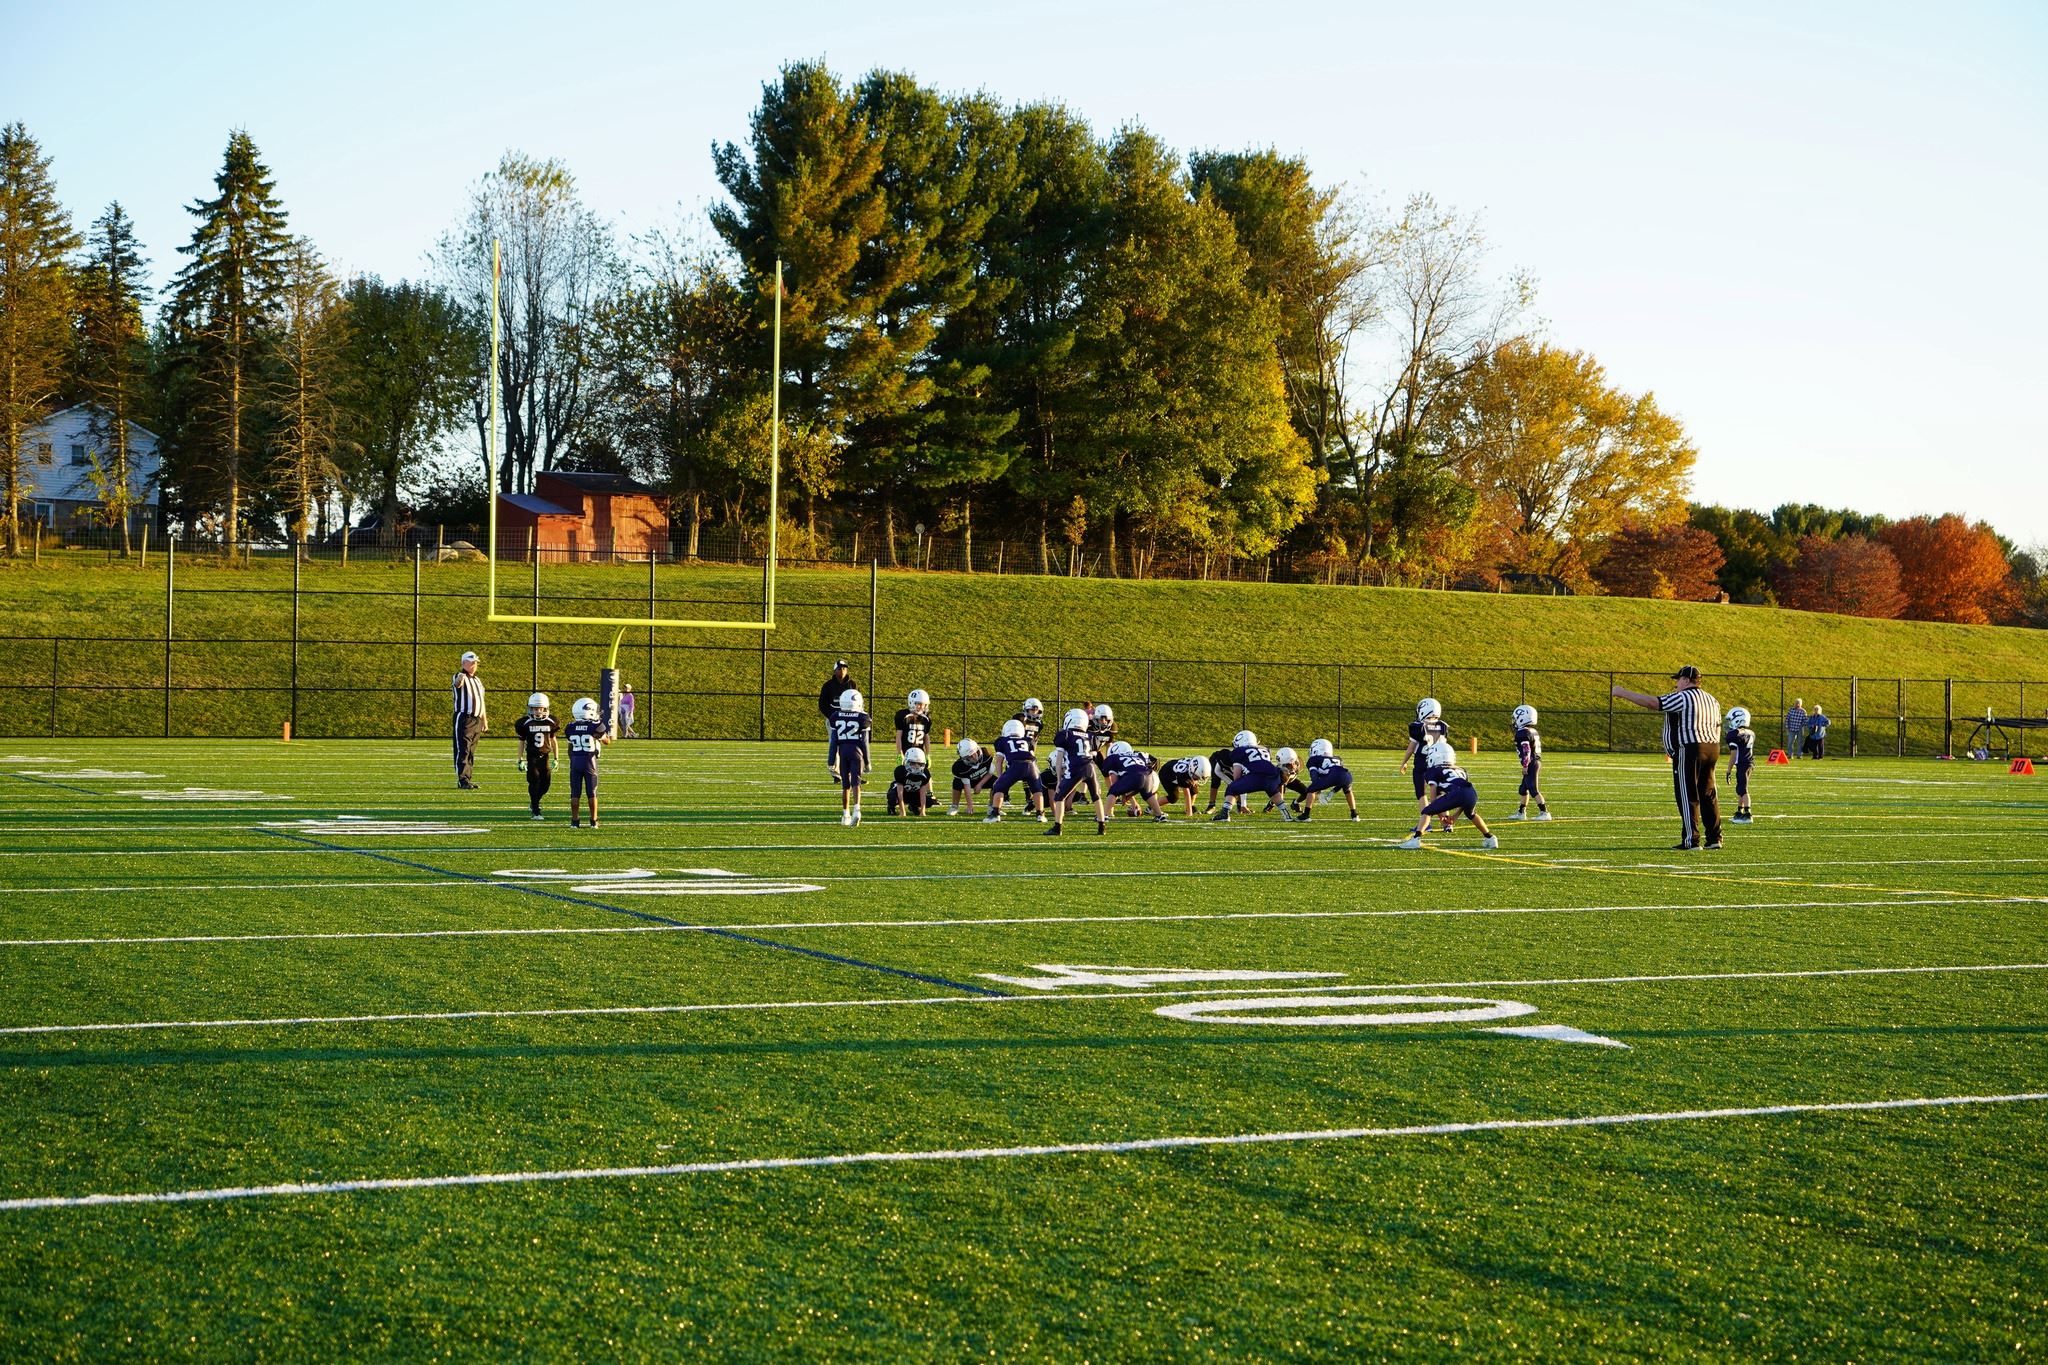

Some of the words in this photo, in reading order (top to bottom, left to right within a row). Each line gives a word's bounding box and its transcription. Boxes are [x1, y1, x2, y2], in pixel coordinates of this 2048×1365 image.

[835, 720, 859, 740] 22
[907, 730, 925, 745] 82
[534, 732, 545, 748] 9
[1007, 740, 1029, 752] 13
[2011, 760, 2026, 772] 10
[975, 964, 1539, 1025] 40
